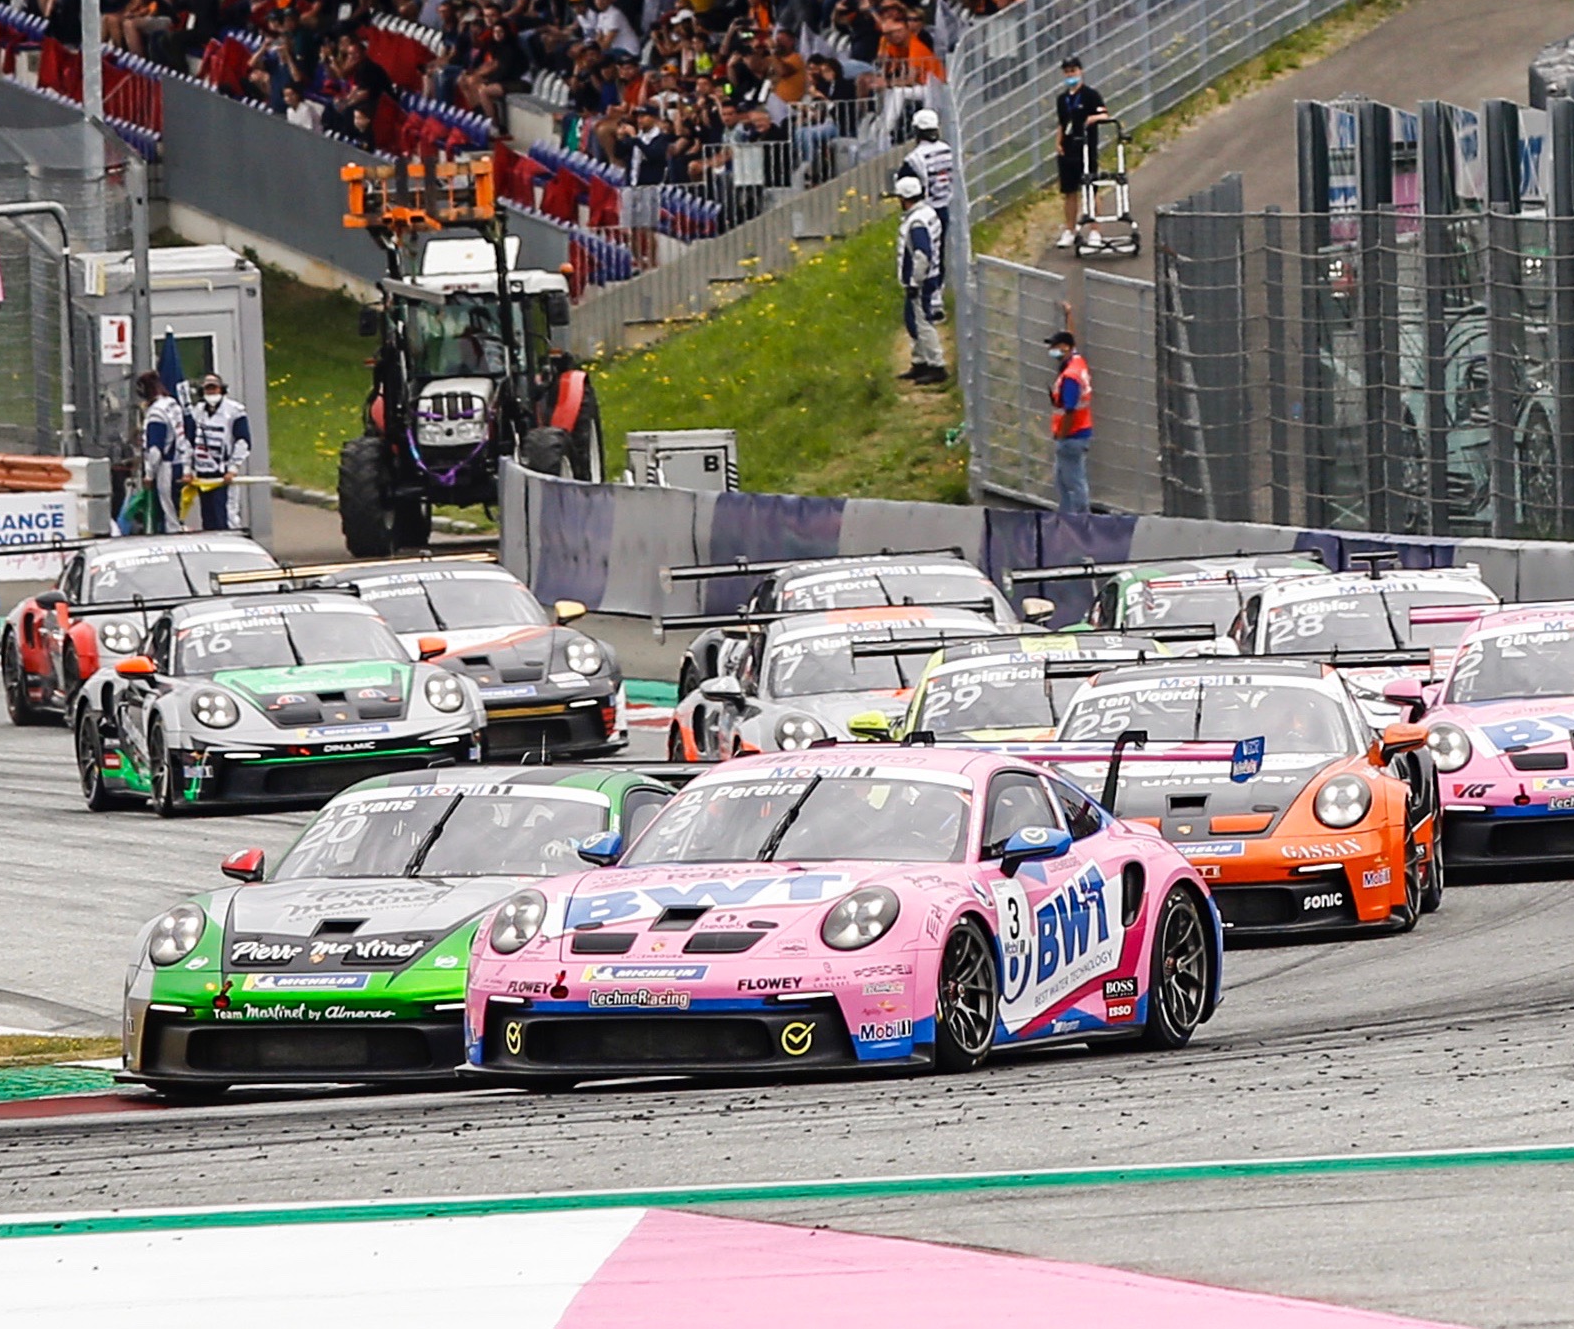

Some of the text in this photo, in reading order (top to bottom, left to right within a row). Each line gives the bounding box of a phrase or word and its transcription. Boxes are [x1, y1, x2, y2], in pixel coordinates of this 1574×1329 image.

[704, 455, 719, 472] B
[97, 571, 118, 587] 4
[813, 579, 880, 596] Latorre
[1339, 582, 1396, 595] Mobil
[1291, 598, 1360, 617] Köhler
[1269, 615, 1325, 645] 28
[187, 633, 232, 658] 16
[1009, 650, 1073, 663] Mobil
[778, 654, 805, 682] 7
[1454, 653, 1484, 682] 2
[927, 667, 1045, 694] L. Heinrich
[1158, 676, 1226, 689] Mobil
[925, 684, 983, 719] 29
[1075, 688, 1206, 716] L. ten Voorde
[1071, 706, 1132, 740] 25
[324, 741, 375, 752] DINAMIC
[768, 766, 845, 779] Mobil
[409, 784, 485, 797] Mobil
[679, 780, 808, 808] D. Pereira
[343, 799, 418, 817] Evans
[659, 803, 702, 836] 3
[294, 814, 367, 855] 20
[1281, 838, 1364, 859] GASSAN
[284, 889, 447, 917] Martinet
[565, 873, 843, 930] BWT
[1007, 897, 1020, 939] 3
[1036, 864, 1110, 986] BWT
[231, 939, 424, 962] Pierre Martinet
[277, 976, 358, 987] MICHELIN
[615, 967, 698, 978] MICHELIN
[507, 980, 552, 995] FLOWEY
[737, 976, 803, 991] FLOWEY
[1105, 979, 1134, 994] BOSS
[213, 1002, 396, 1021] Team Martinet by Almeras
[859, 1022, 900, 1042] Mobil
